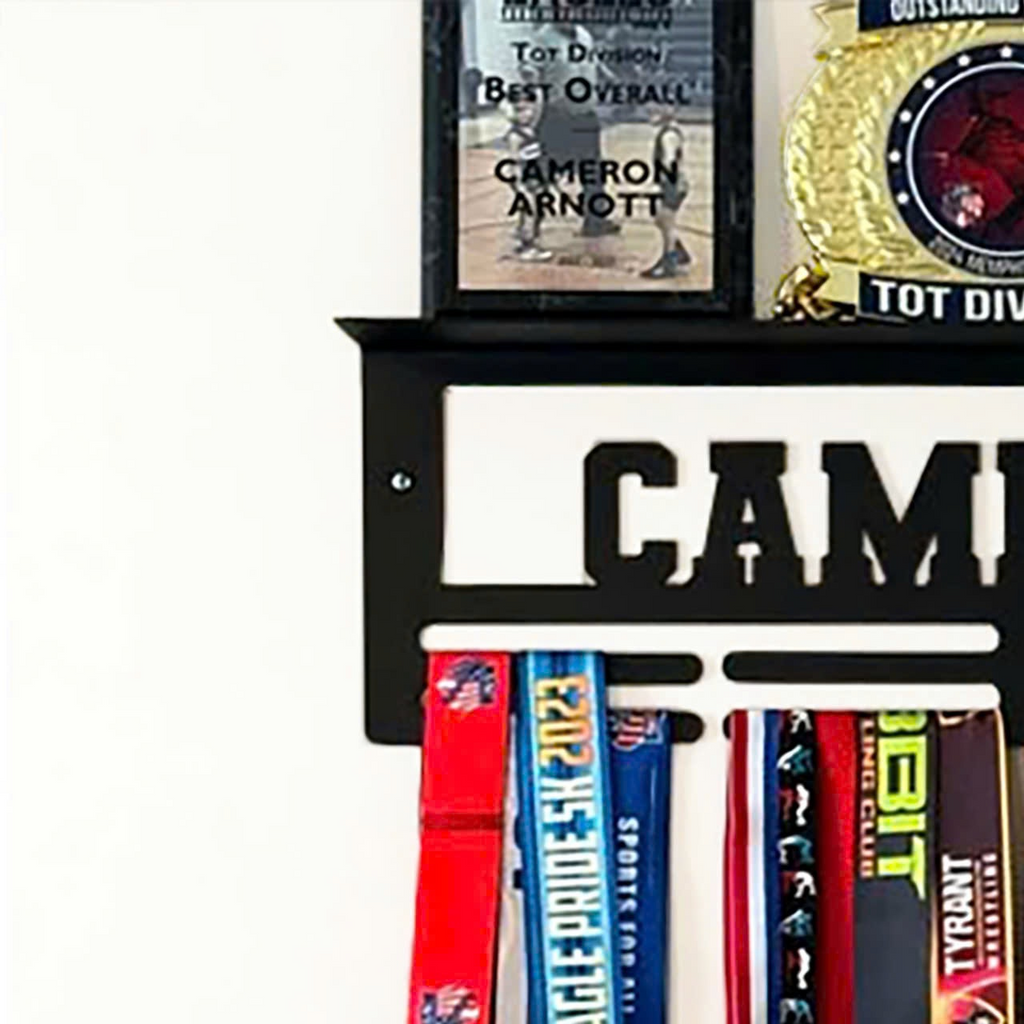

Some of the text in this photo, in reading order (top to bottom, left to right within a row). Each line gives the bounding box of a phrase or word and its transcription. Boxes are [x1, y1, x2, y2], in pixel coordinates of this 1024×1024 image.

[494, 159, 678, 184] CAMERON
[508, 193, 665, 218] ARNOTT
[870, 278, 951, 320] TOT
[535, 675, 595, 768] 2023
[544, 829, 604, 939] PRIDE
[942, 854, 976, 976] TYRANT
